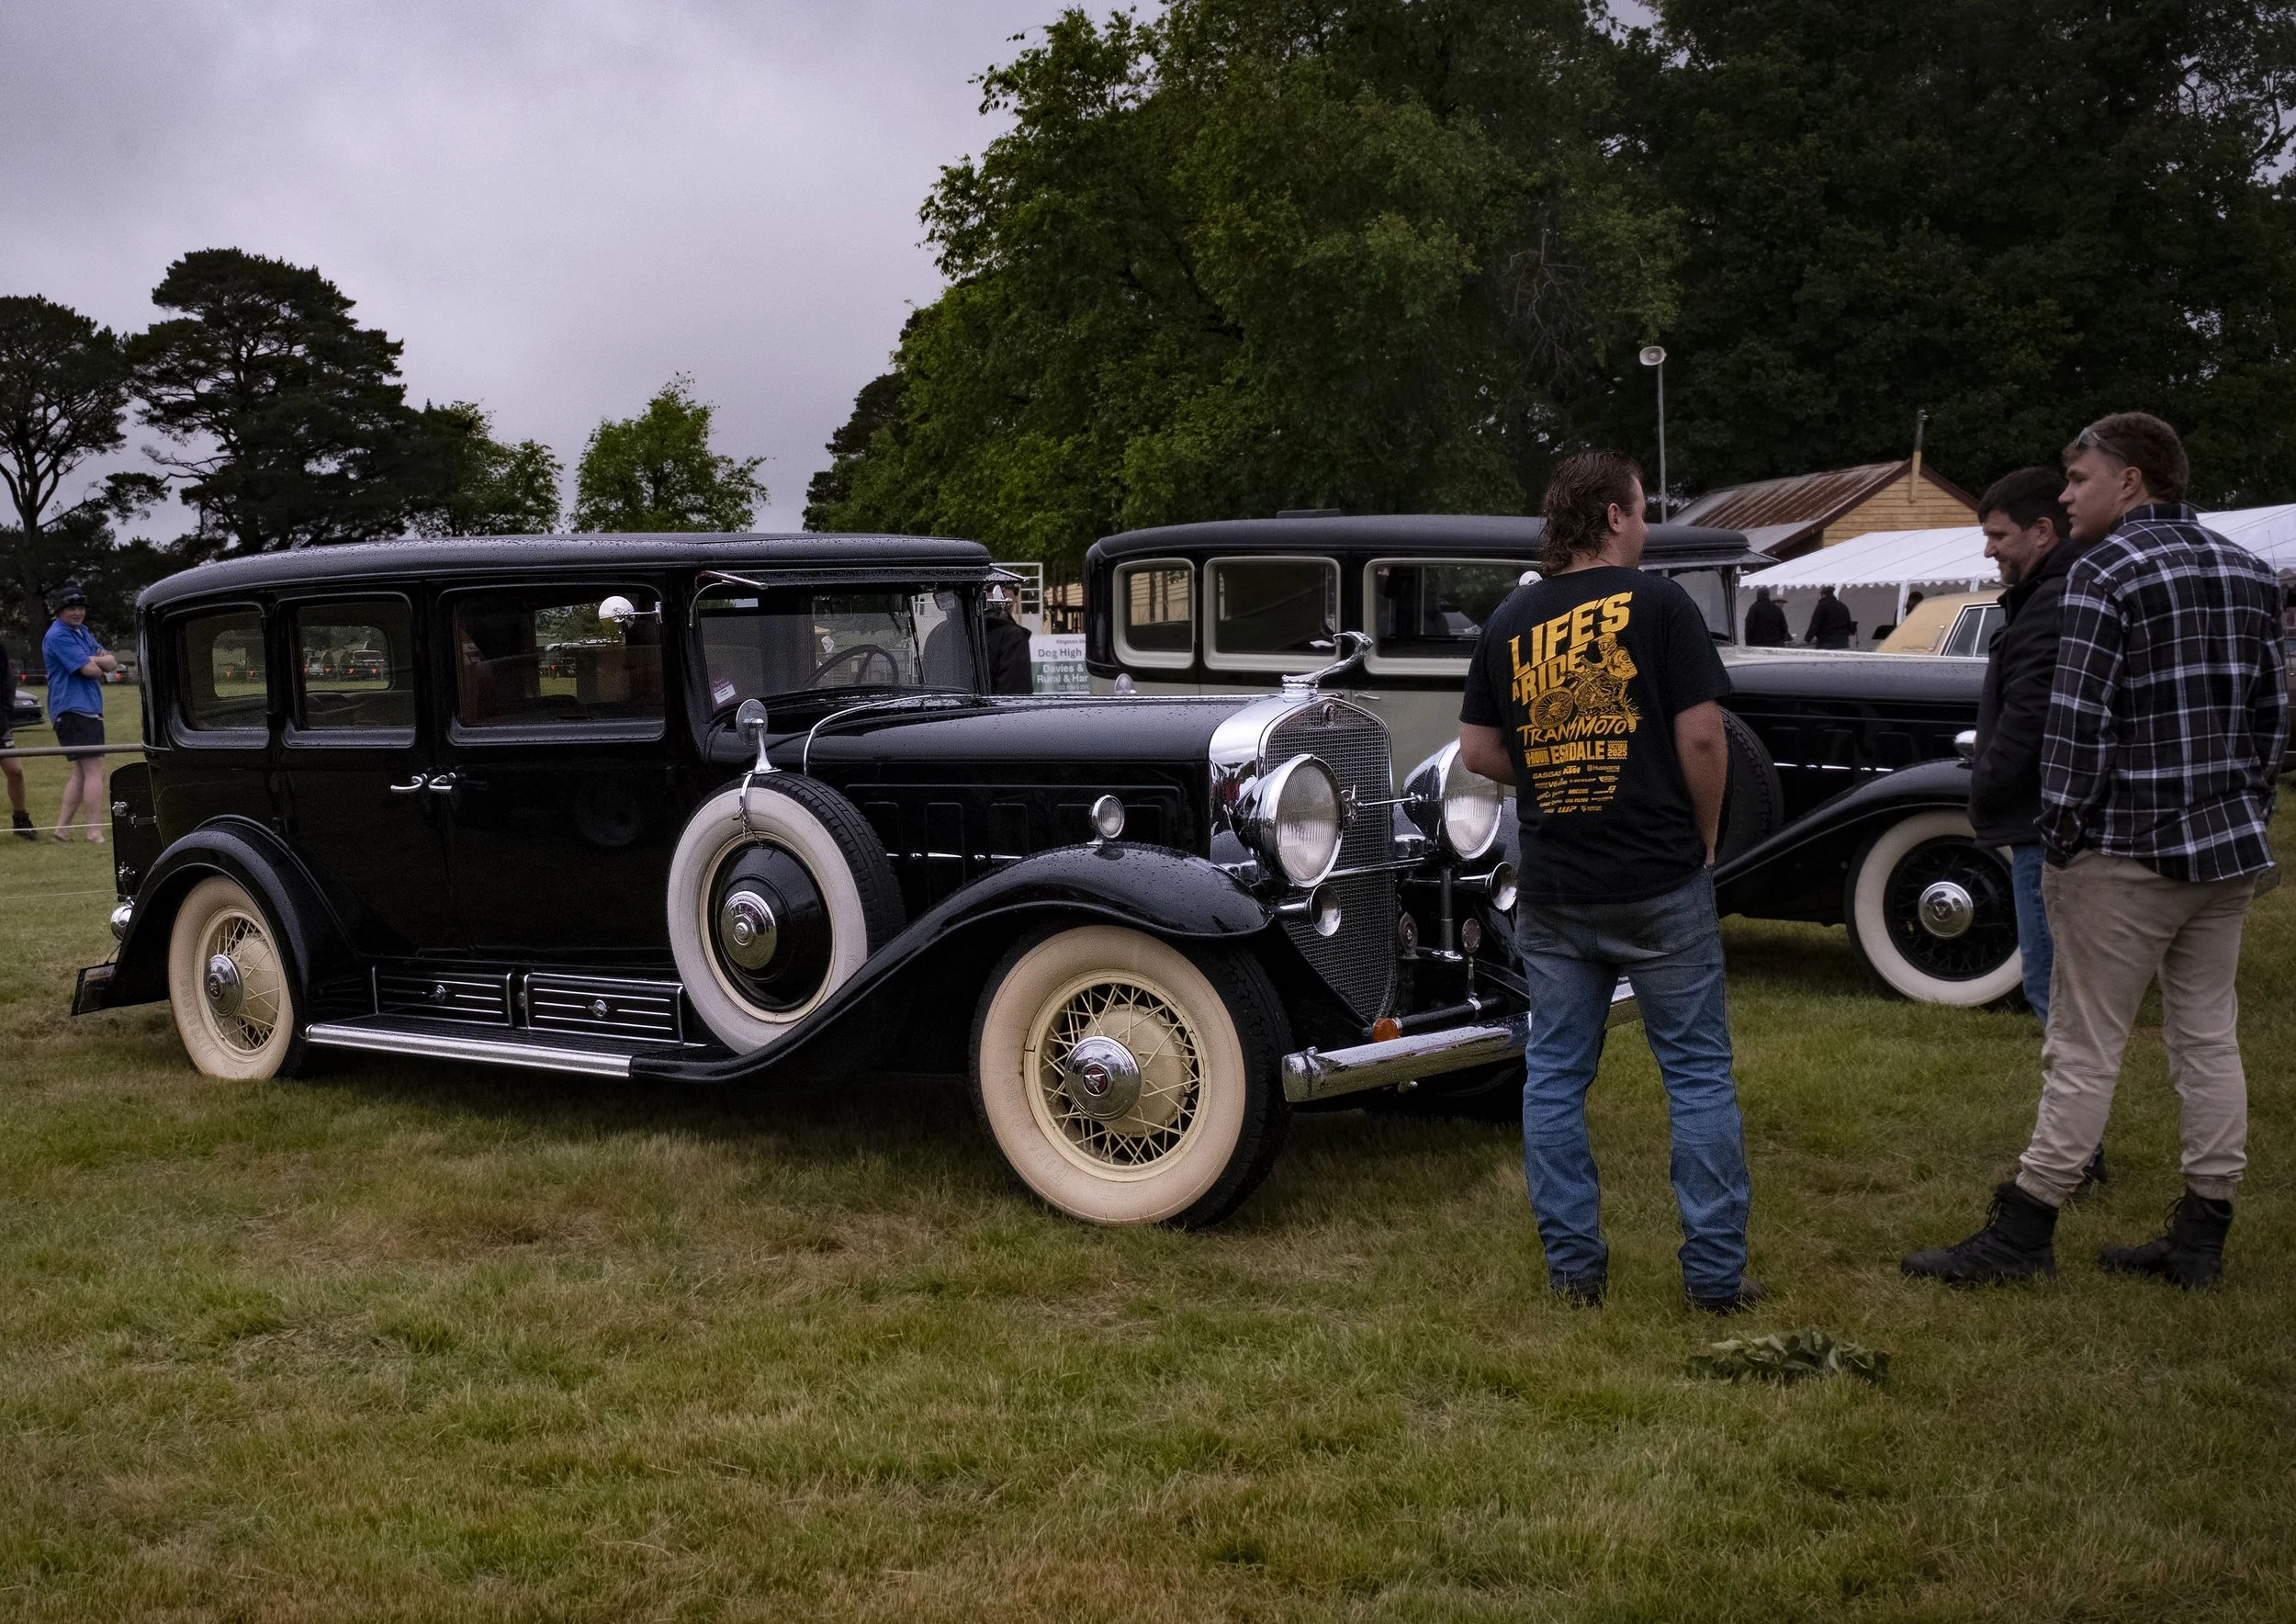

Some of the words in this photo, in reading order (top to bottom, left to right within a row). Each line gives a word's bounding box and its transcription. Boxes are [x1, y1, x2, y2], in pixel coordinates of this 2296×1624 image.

[1508, 592, 1633, 680] LIFE'S
[1038, 648, 1057, 659] Dog
[1060, 648, 1082, 659] High
[1042, 663, 1075, 672] Davies
[1076, 663, 1084, 672] &
[1037, 674, 1061, 683] Rural
[1064, 674, 1071, 682] &
[1512, 682, 1520, 702] A
[1520, 643, 1588, 706] RIDE
[1516, 714, 1627, 746] TRANSMOTO
[1607, 749, 1627, 757] 2025
[1533, 771, 1562, 779] GASGAS
[1562, 765, 1581, 774] KTM
